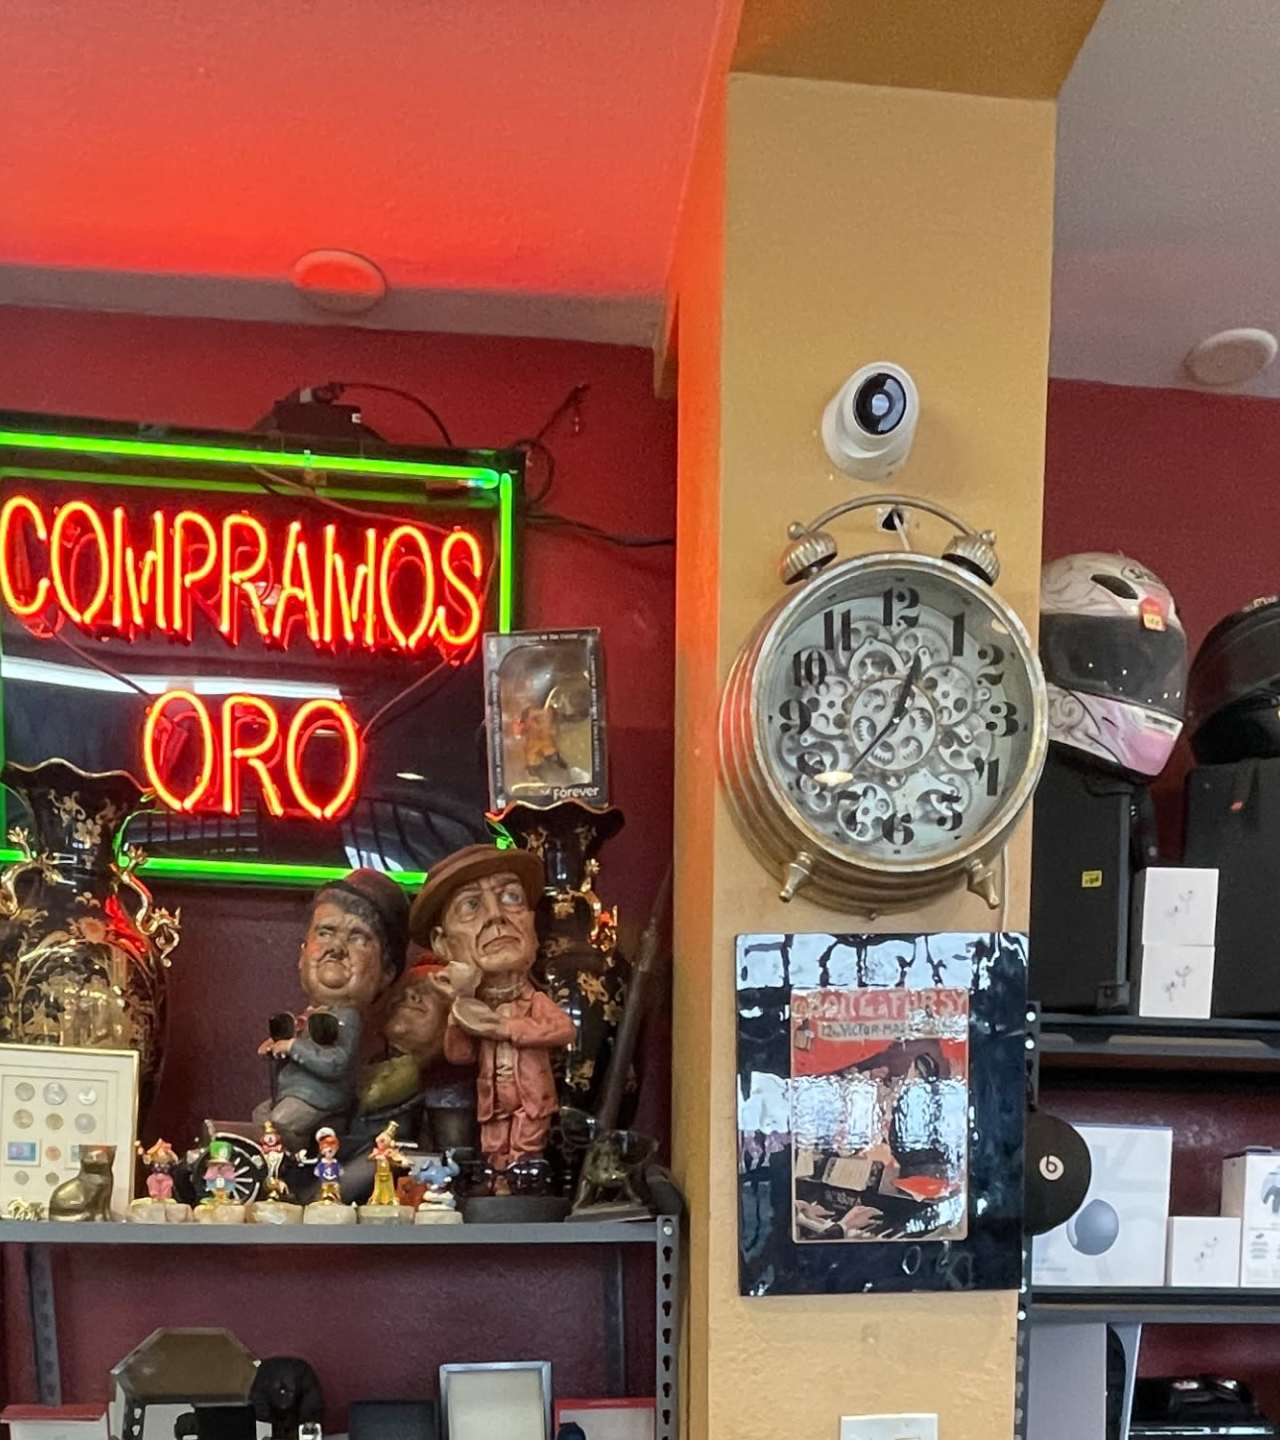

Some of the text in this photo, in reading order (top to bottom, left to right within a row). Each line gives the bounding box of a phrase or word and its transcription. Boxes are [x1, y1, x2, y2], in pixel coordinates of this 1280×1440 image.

[882, 586, 921, 629] 12
[824, 610, 852, 651] 11
[952, 611, 966, 656] 1
[793, 650, 827, 687] 10
[976, 644, 1005, 686] 2
[778, 698, 813, 734] 9
[984, 700, 1020, 738] 3
[143, 689, 361, 817] ORO
[553, 786, 600, 800] Forever
[881, 812, 915, 846] 6
